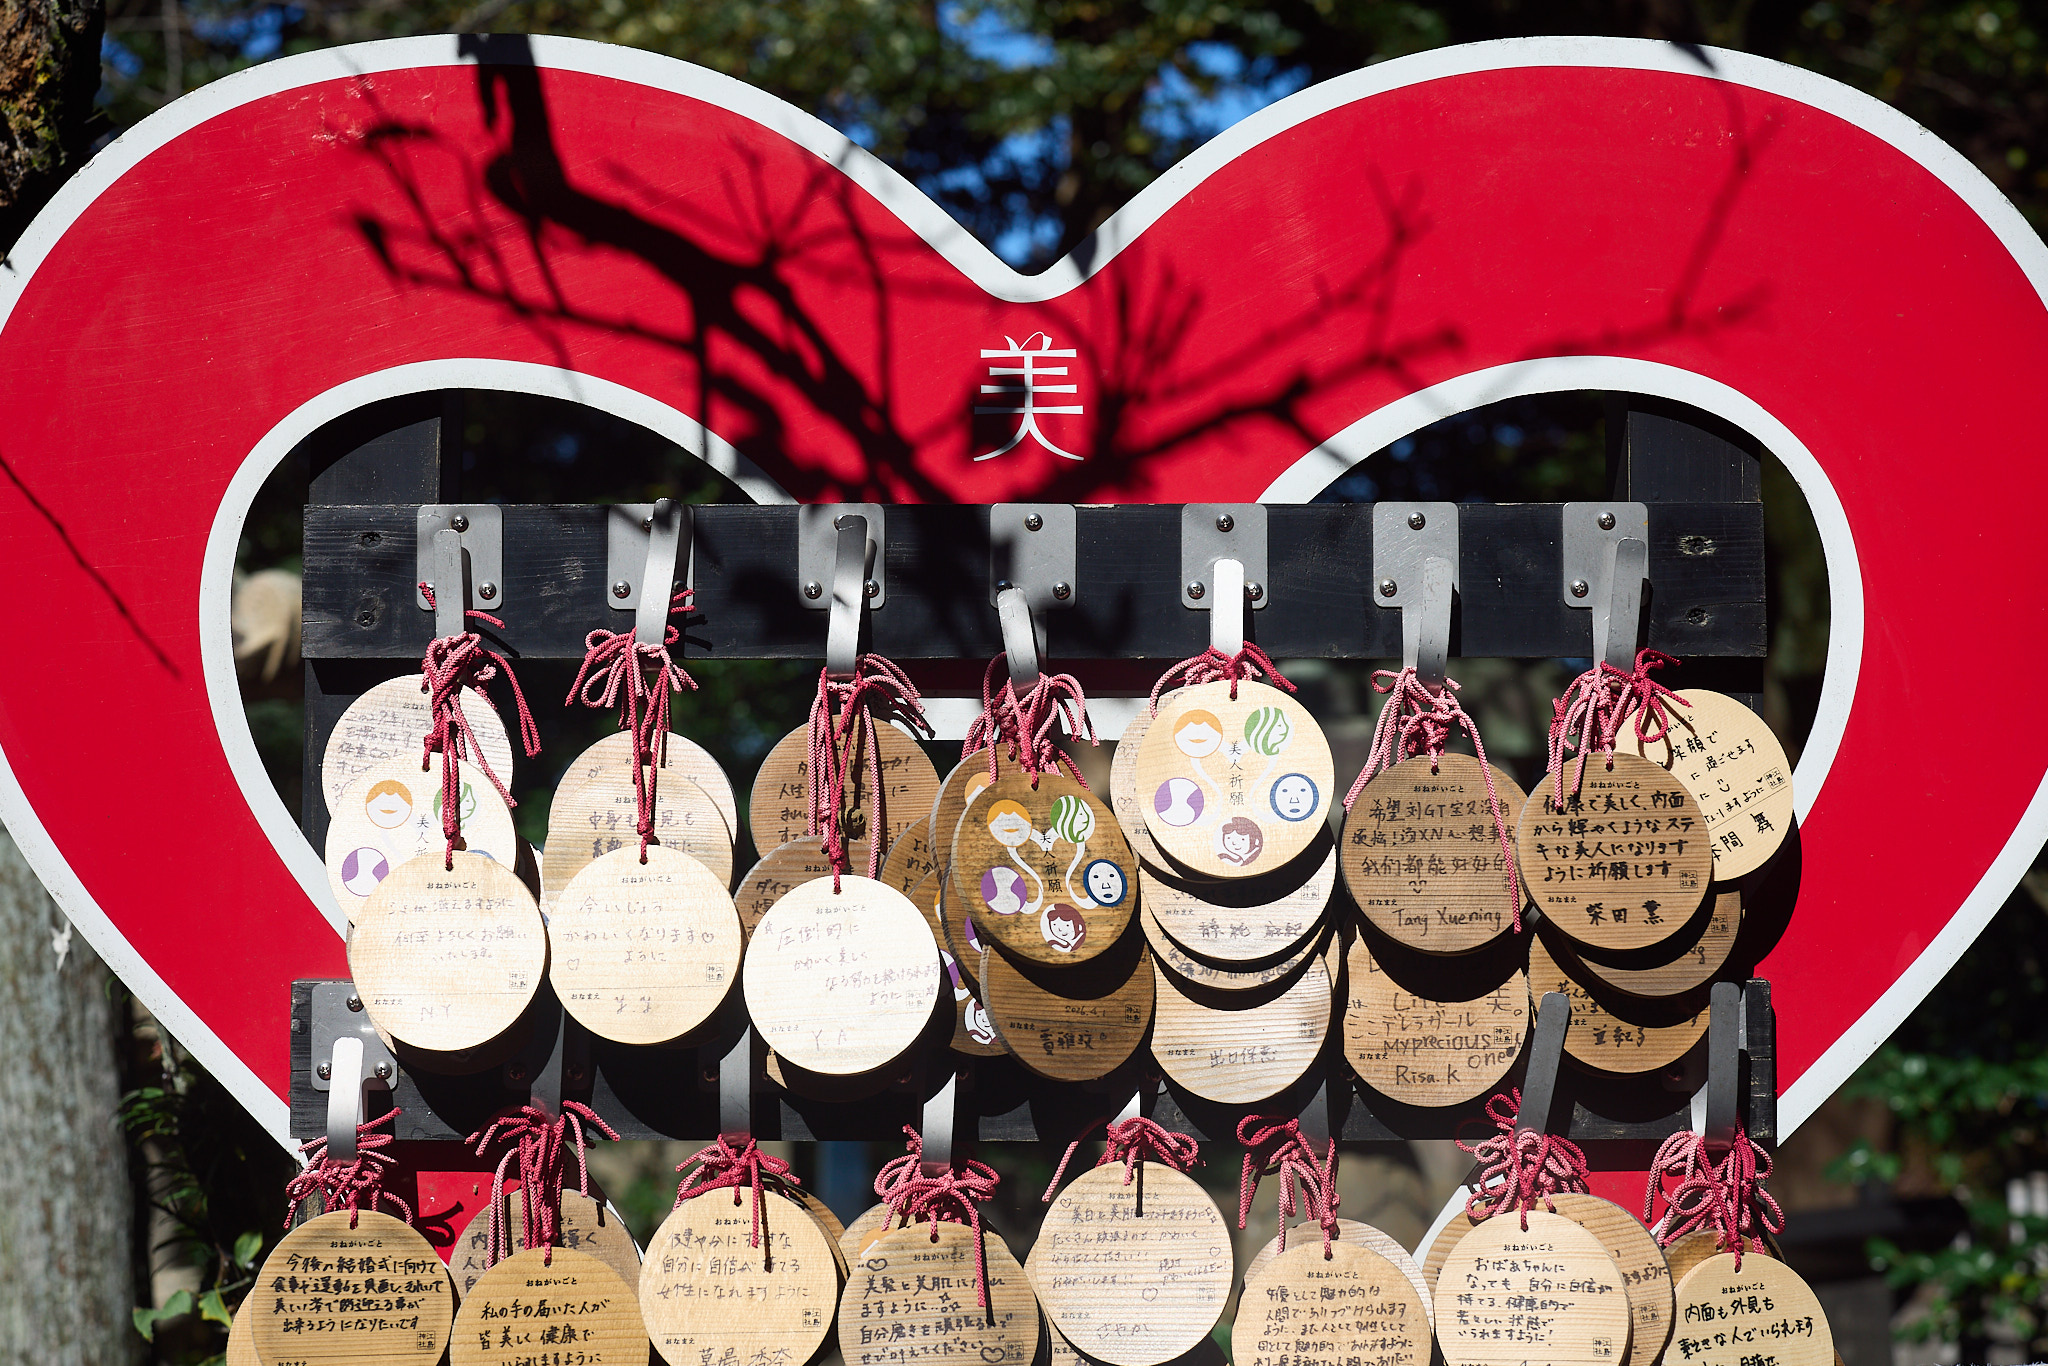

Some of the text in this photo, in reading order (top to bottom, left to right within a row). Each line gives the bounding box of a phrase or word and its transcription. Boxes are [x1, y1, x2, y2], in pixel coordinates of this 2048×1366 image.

[974, 331, 1085, 462] 美
[1229, 741, 1245, 806] 美人祈願
[1414, 785, 1464, 793] おねがいごと
[1590, 781, 1640, 789] おねがいごと
[1040, 829, 1063, 893] 美人祈願
[1544, 861, 1672, 883] ように祈願します
[816, 905, 867, 914] おねがいごと
[1392, 908, 1428, 936] Tang
[624, 950, 667, 963] ように
[330, 1239, 383, 1248] おねがいごと
[1504, 1243, 1554, 1251] おねがいごと
[286, 1253, 437, 1275] 今後の結婚式に向けて
[1474, 1257, 1566, 1273] おばあちゃんに
[526, 1277, 577, 1287] おねがいごと
[1307, 1271, 1359, 1280] おねがいごと
[1721, 1282, 1765, 1294] おねがいごと
[480, 1299, 611, 1321] 私の手の届いた人が
[1685, 1296, 1774, 1323] 内面も外見も
[283, 1316, 419, 1335] 出来るようになりたいです
[479, 1323, 595, 1351] 皆美しく健康で
